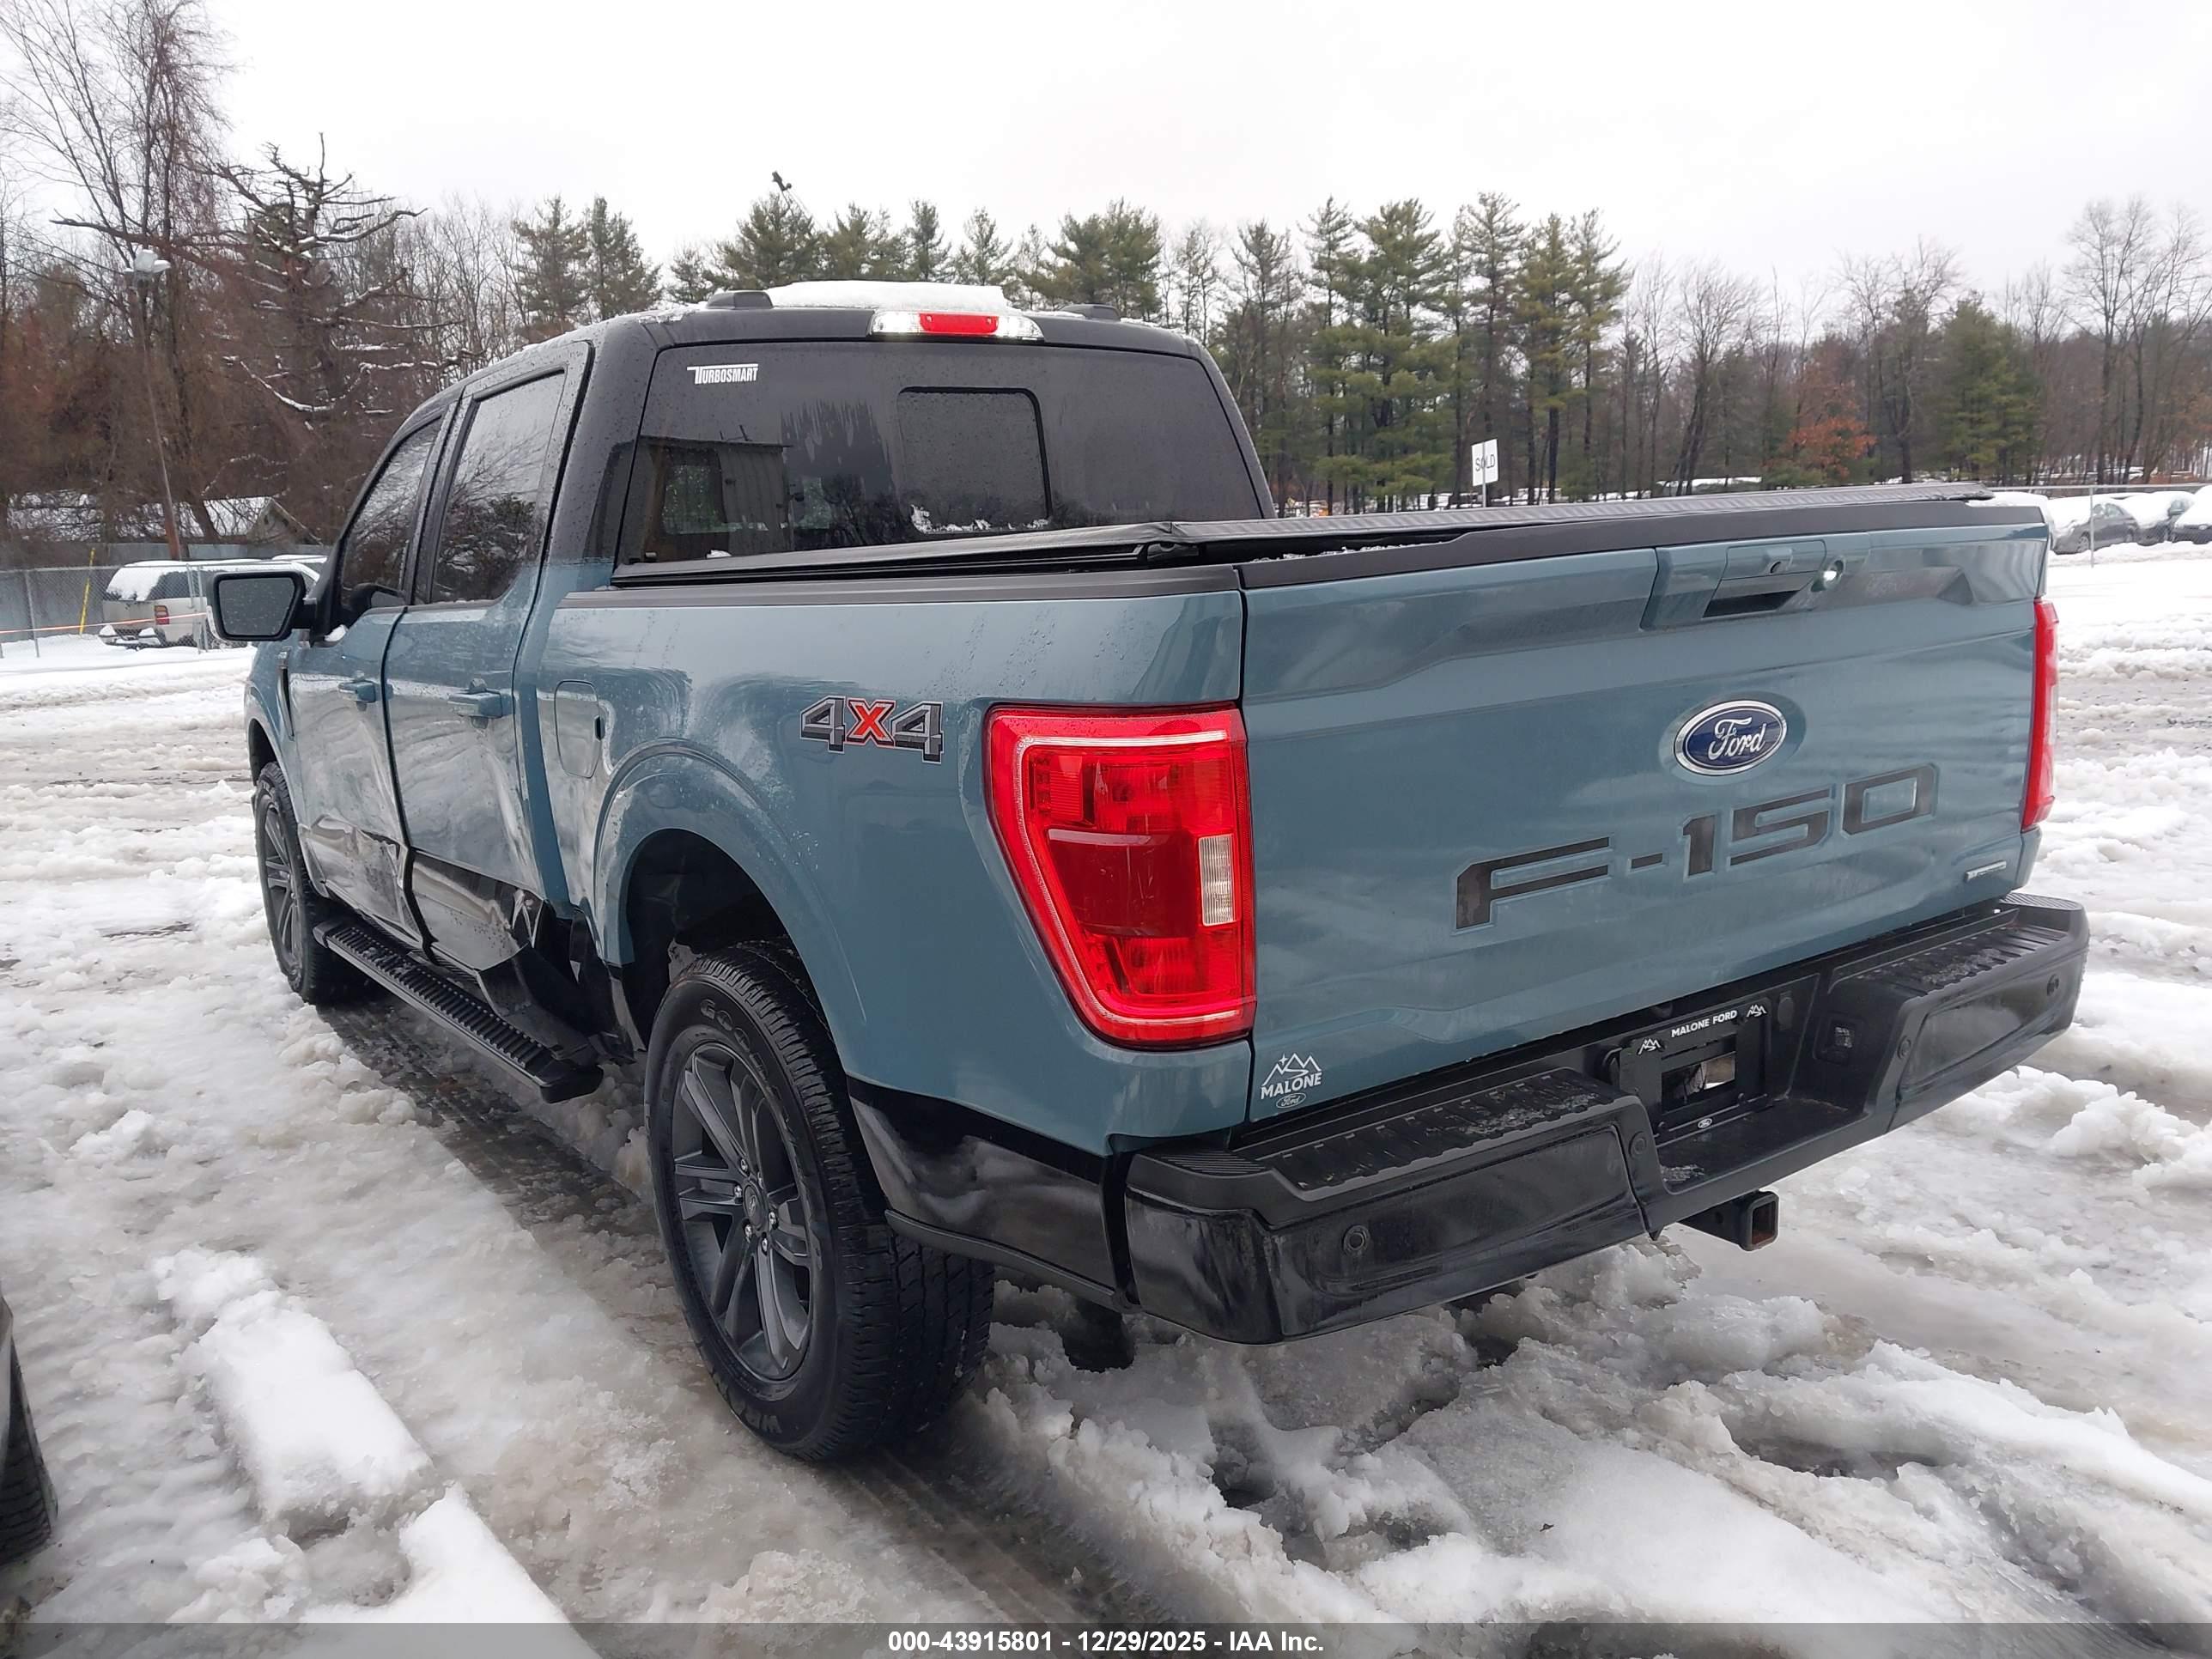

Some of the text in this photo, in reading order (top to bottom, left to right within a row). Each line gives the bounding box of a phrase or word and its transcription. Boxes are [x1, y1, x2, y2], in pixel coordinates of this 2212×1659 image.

[686, 363, 759, 385] TURBOSMART
[1475, 453, 1496, 472] SOLD
[1707, 717, 1767, 760] Ford
[1454, 763, 1939, 933] F-150
[1670, 1009, 1738, 1037] MALONE FORD
[1261, 1073, 1322, 1100] MALONE
[1279, 1094, 1303, 1108] Ford
